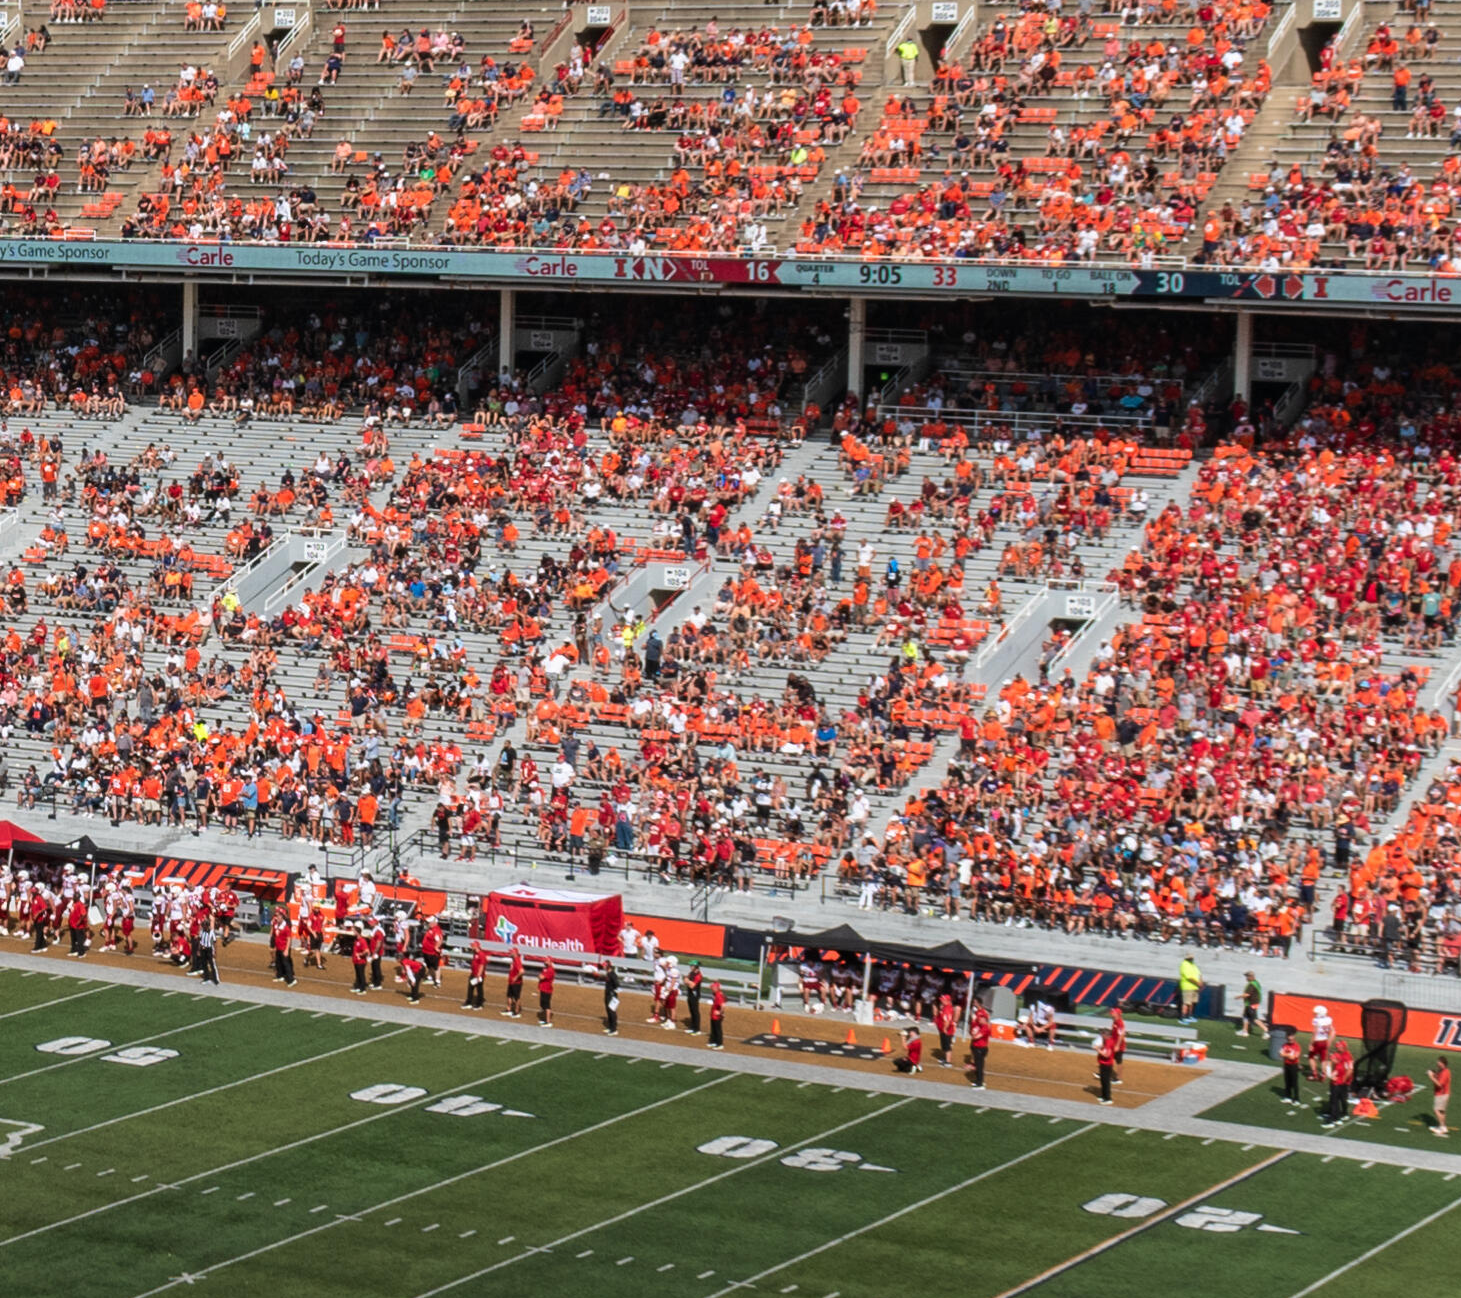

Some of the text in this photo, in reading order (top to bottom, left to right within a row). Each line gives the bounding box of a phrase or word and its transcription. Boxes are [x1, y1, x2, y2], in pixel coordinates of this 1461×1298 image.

[18, 243, 56, 258] Game
[57, 245, 110, 261] Sponsor
[187, 247, 234, 265] Carle
[296, 251, 346, 270] Today's
[348, 253, 390, 268] Game
[393, 254, 451, 271] Sponsor
[525, 257, 578, 276] Carle
[691, 260, 1240, 293] TOL 16 QUARTER 9:05 33 DOWN TO GO BALL ON 30 TOL
[812, 274, 820, 285] 4
[987, 280, 1009, 292] 2ND
[1102, 282, 1116, 295] 18
[1386, 279, 1452, 302] Carle
[516, 934, 584, 952] CHI Health
[34, 1034, 182, 1067] 50
[347, 1081, 505, 1118] 40
[696, 1134, 865, 1173] 30
[1081, 1191, 1266, 1235] 20
